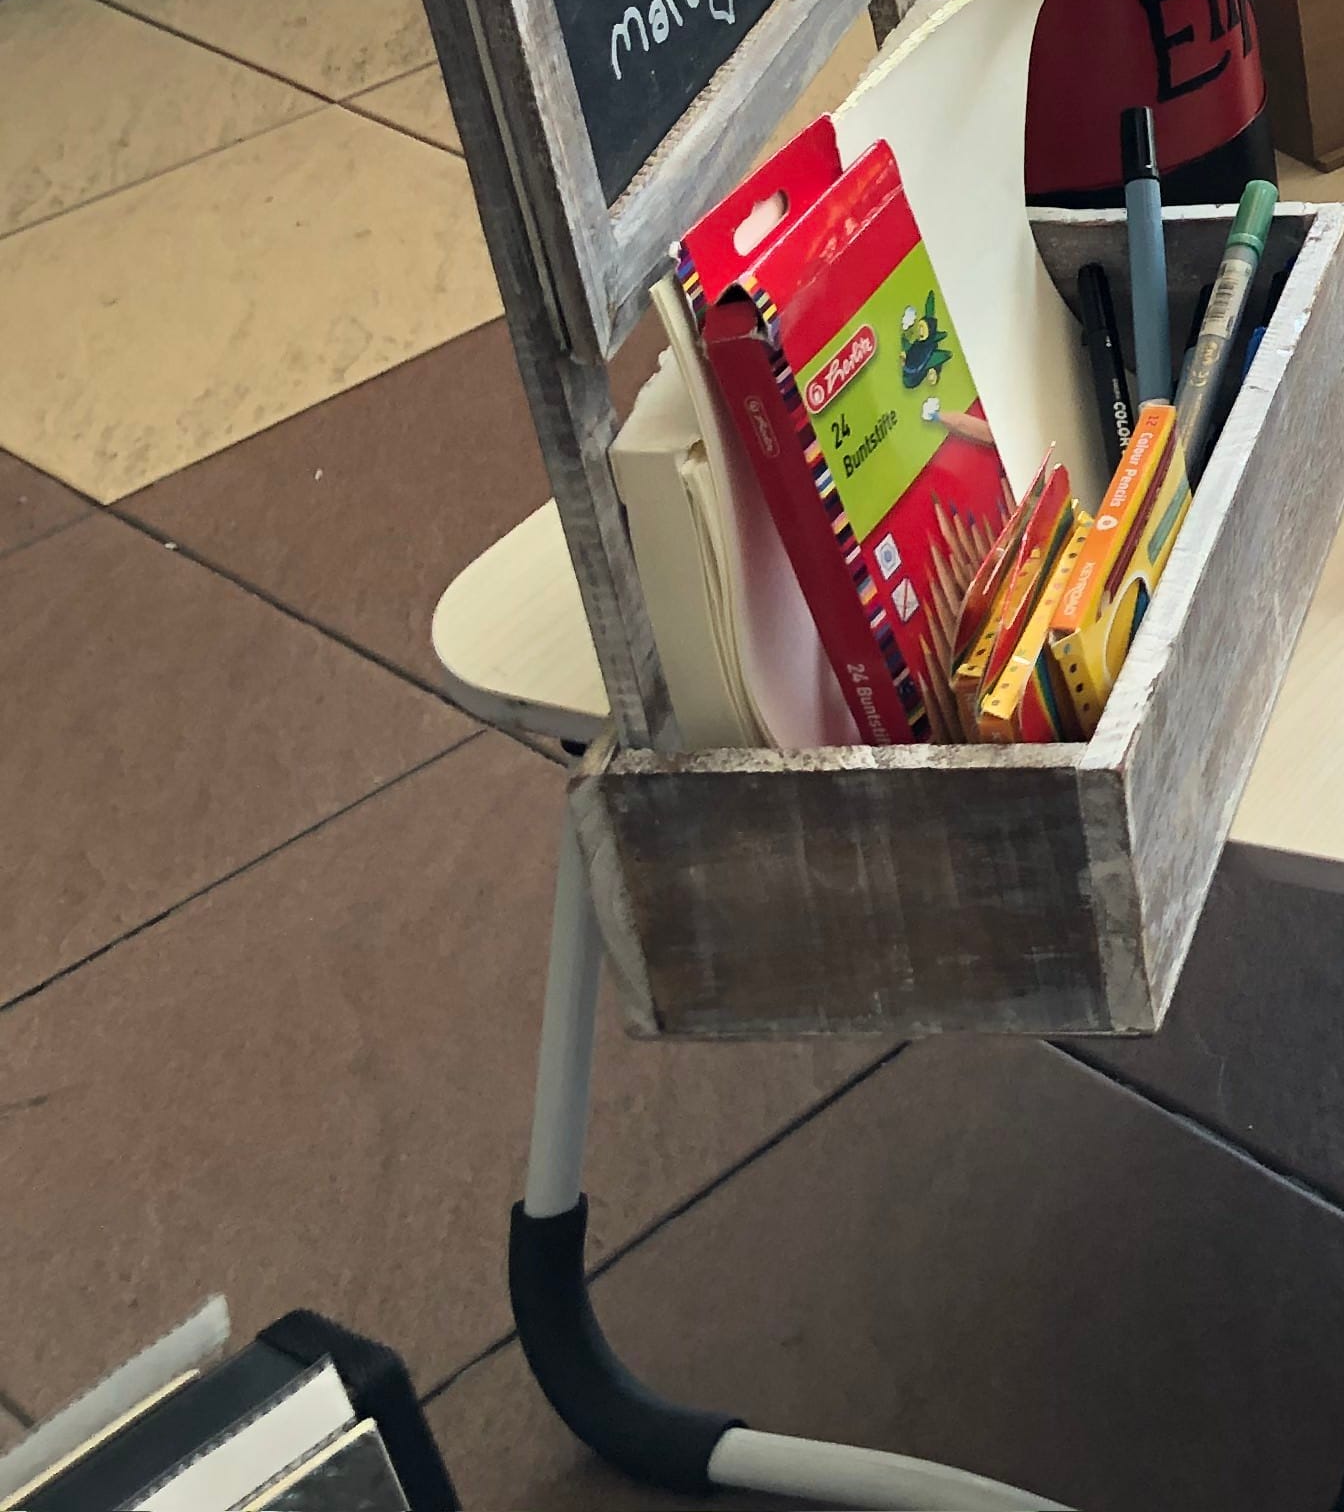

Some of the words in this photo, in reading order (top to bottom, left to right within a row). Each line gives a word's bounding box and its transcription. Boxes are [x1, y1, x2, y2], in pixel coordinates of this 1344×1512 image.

[831, 413, 852, 450] 24
[843, 410, 899, 478] Buntstifte
[1128, 432, 1155, 466] Colour
[1109, 467, 1138, 508] Pencils
[846, 663, 869, 684] 24
